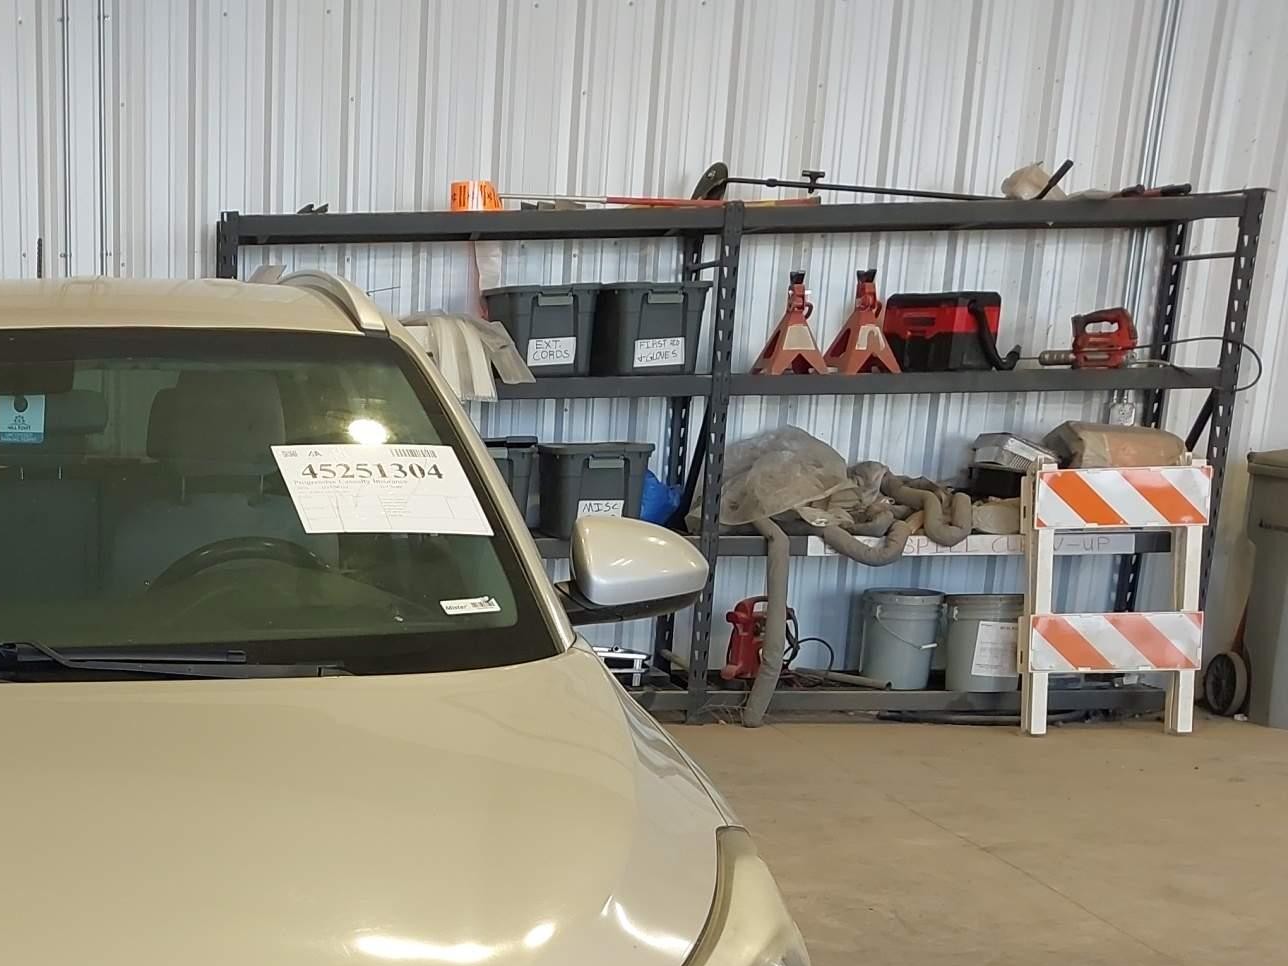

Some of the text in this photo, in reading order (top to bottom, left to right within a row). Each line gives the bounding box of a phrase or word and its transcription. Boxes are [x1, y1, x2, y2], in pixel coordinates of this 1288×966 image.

[535, 339, 562, 350] EXT.
[639, 339, 667, 350] FIRST
[532, 349, 570, 361] CORDS
[301, 463, 444, 479] 45251304
[582, 502, 620, 513] MISC
